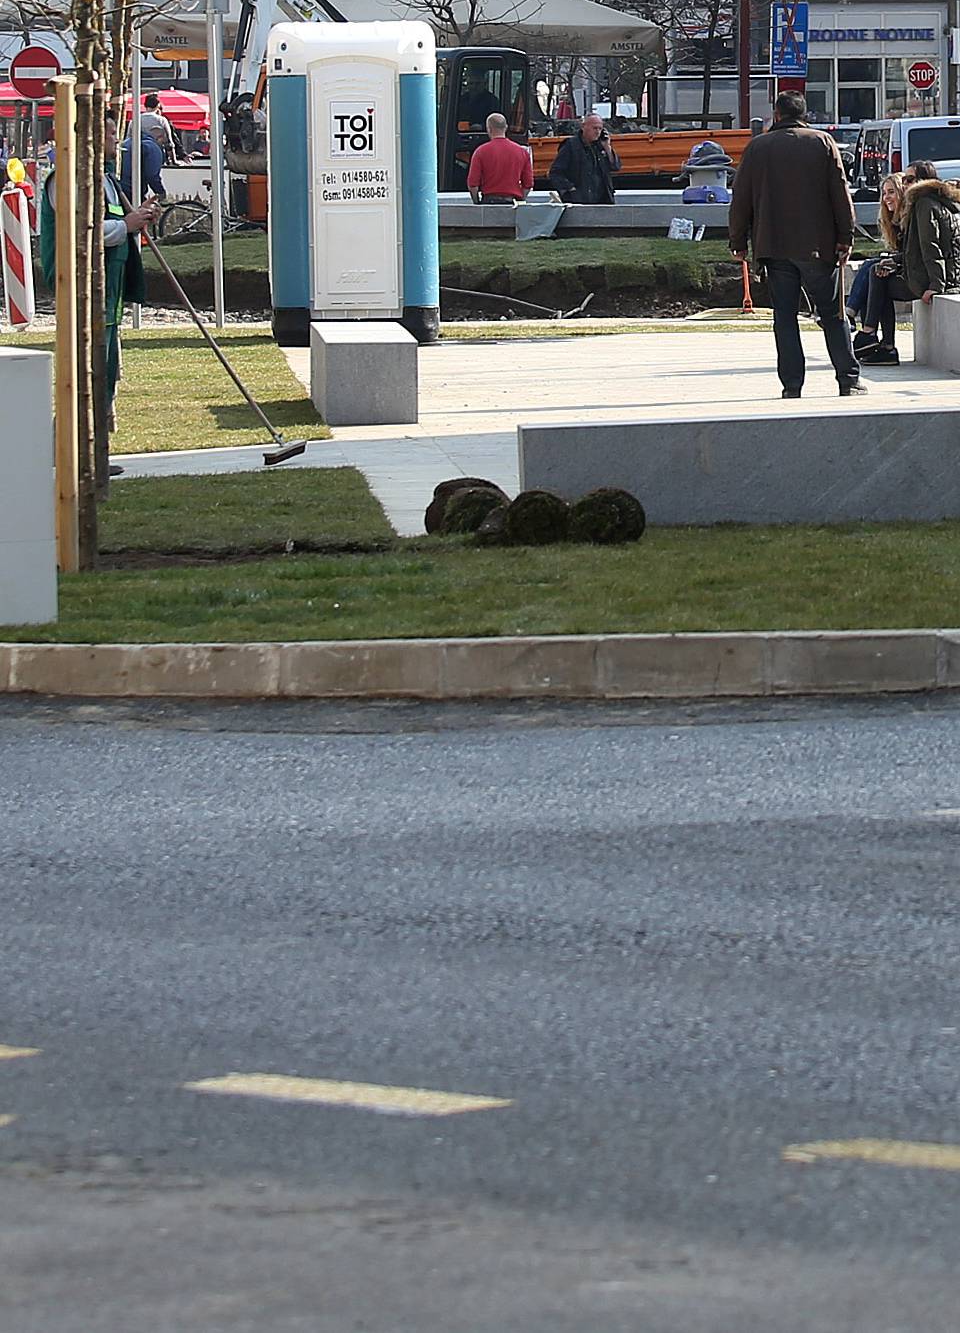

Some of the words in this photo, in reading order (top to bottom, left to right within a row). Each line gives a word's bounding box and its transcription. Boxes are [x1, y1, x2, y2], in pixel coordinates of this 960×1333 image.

[154, 35, 189, 45] AMSTEL
[874, 28, 935, 42] NOVINE
[610, 42, 646, 51] AMSTEL
[909, 68, 934, 82] STOP
[334, 114, 373, 133] TOI
[334, 133, 373, 151] TOI
[321, 173, 336, 185] Tel:
[322, 189, 341, 201] Gsm:
